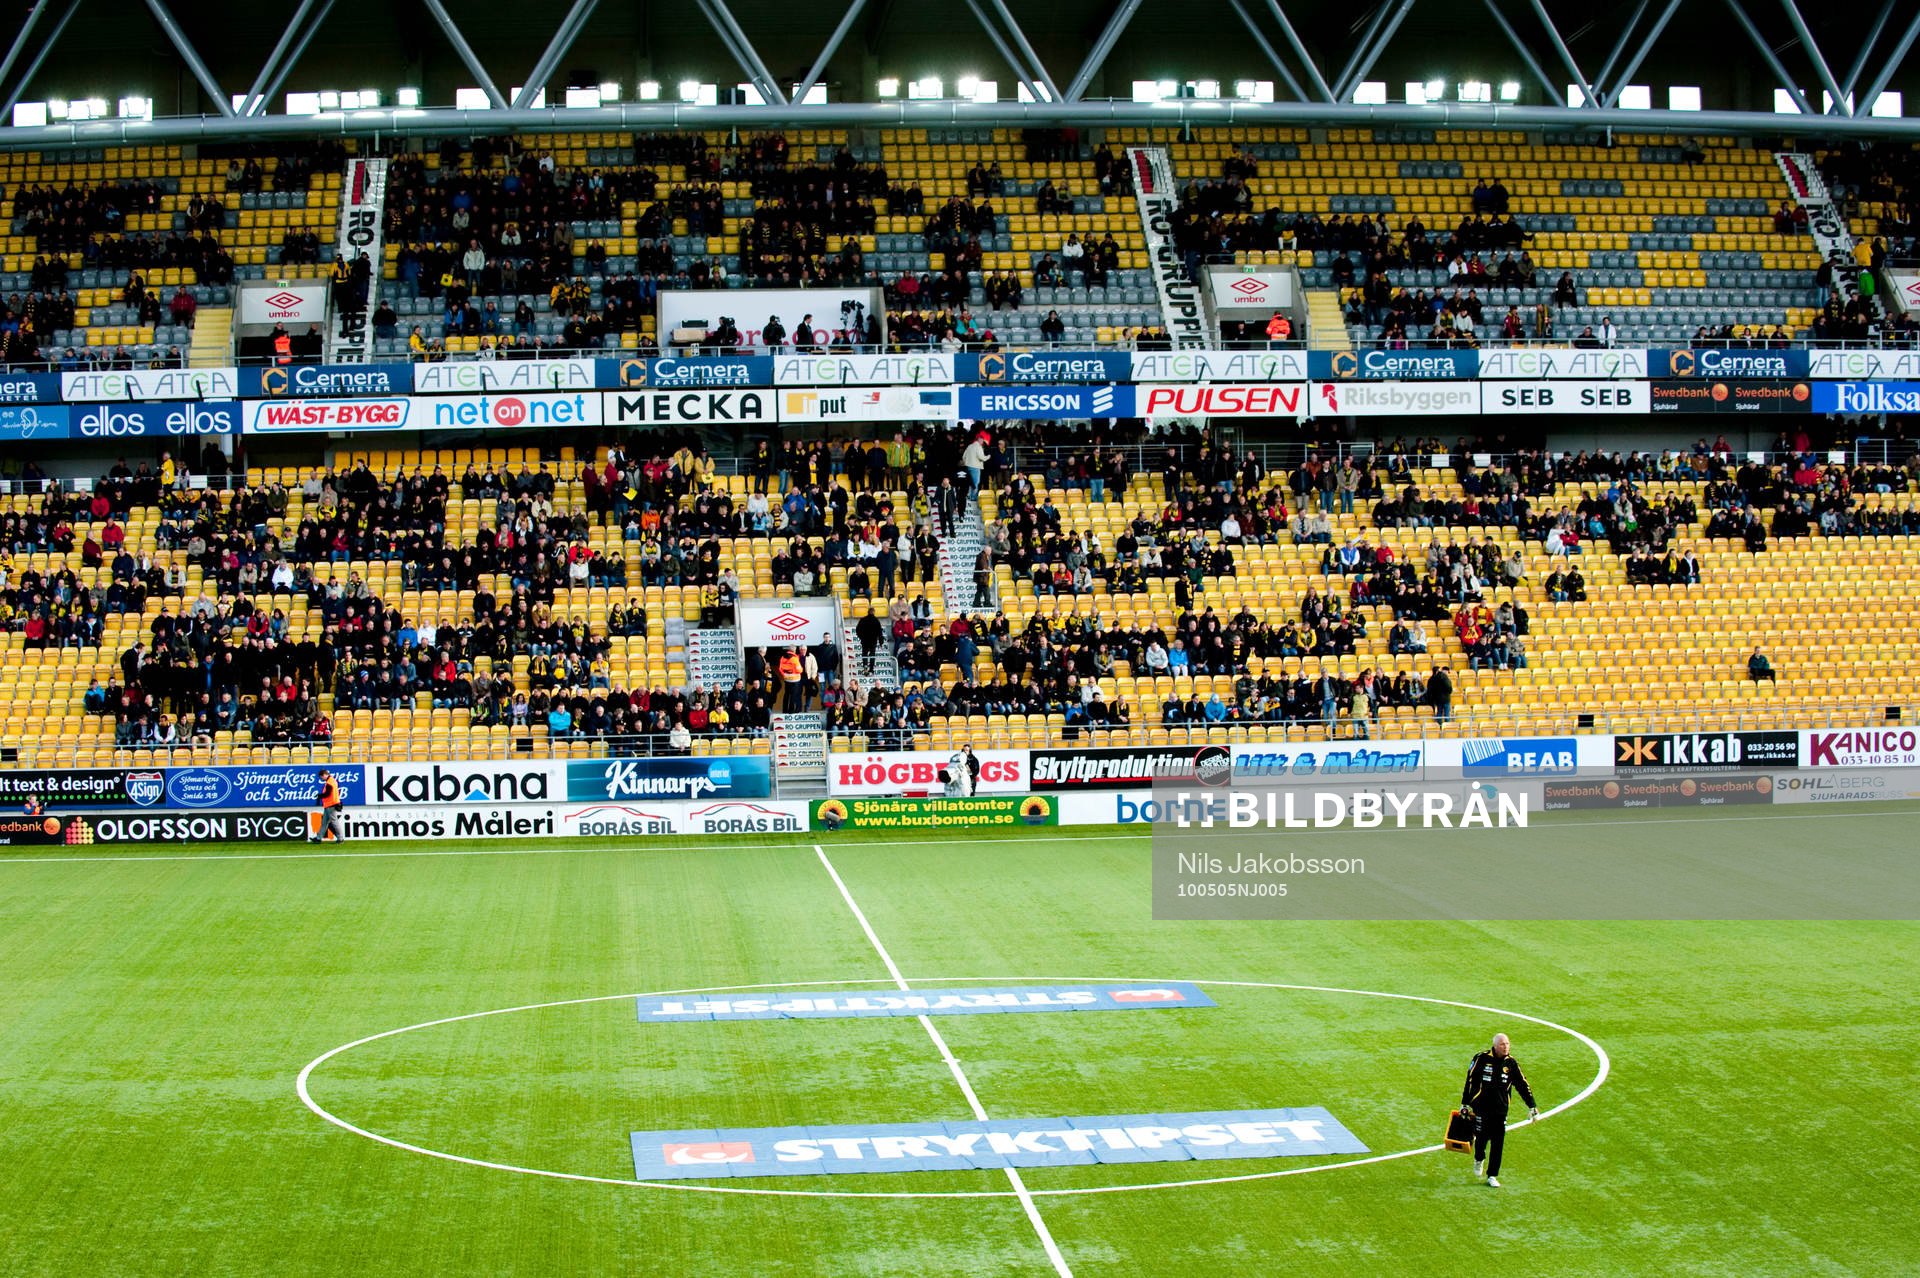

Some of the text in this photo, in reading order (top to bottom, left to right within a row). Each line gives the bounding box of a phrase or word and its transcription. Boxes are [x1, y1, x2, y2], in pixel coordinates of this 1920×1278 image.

[655, 359, 749, 378] Cernera
[780, 358, 948, 380] ATEA ATEA
[1013, 353, 1105, 373] Cernera
[1137, 355, 1301, 377] ATEA ATEA
[1365, 352, 1455, 370] Cernera
[1485, 353, 1641, 374] ATEA ATEA
[1701, 350, 1786, 370] Cernera
[1815, 354, 1884, 374] ATEA
[68, 373, 232, 397] ATEA ATEA
[296, 366, 389, 386] Cernera
[421, 363, 588, 388] ATEA ATEA
[981, 395, 1080, 411] ERICSSON
[1147, 387, 1300, 414] PULSEN
[1345, 387, 1471, 410] Riksbyggen
[1502, 389, 1631, 406] SEB SEB
[1654, 387, 1791, 398] Swedbank Swedbank
[1835, 383, 1920, 412] Folksa
[267, 400, 400, 425] WÄST-BYGG
[618, 393, 761, 421] MECKA
[80, 406, 145, 436] ellos
[166, 404, 231, 434] ellos
[771, 633, 805, 641] umbro
[1663, 734, 1741, 765] ikkab
[1748, 742, 1796, 751] 033-20 56 90
[1748, 751, 1796, 759] www.ikkab.se
[1811, 731, 1916, 765] KANICO
[1032, 754, 1195, 784] Skyltproduktion
[1233, 754, 1288, 777] Lift
[1292, 753, 1316, 775] &
[1321, 748, 1420, 775] Måleri
[1507, 751, 1574, 773] BEAB
[1841, 754, 1915, 765] 033-10 85 10
[180, 776, 219, 784] Sjömarkens
[234, 769, 316, 792] Sjömarkens
[605, 760, 720, 799] Kinnarps
[839, 756, 1020, 785] HÖGBGS
[13, 777, 44, 792] text
[47, 777, 58, 791] &
[131, 782, 159, 800] 4Sign
[377, 765, 548, 802] kabona
[1545, 781, 1754, 797] Swedbank Swedbank Swedbank
[245, 787, 270, 801] och
[274, 787, 318, 802] Smide
[854, 800, 1013, 814] Sjönära villatomter
[97, 816, 305, 839] OLOFSSON BYGG
[337, 811, 553, 838] immos Måleri
[580, 817, 677, 835] BORÅS BIL
[705, 815, 802, 832] BORÅS BIL
[854, 813, 1014, 826] www.buxbomen.se
[651, 990, 1100, 1017] STRYKTIPSET
[772, 1119, 1325, 1163] STRYKTIPSET
